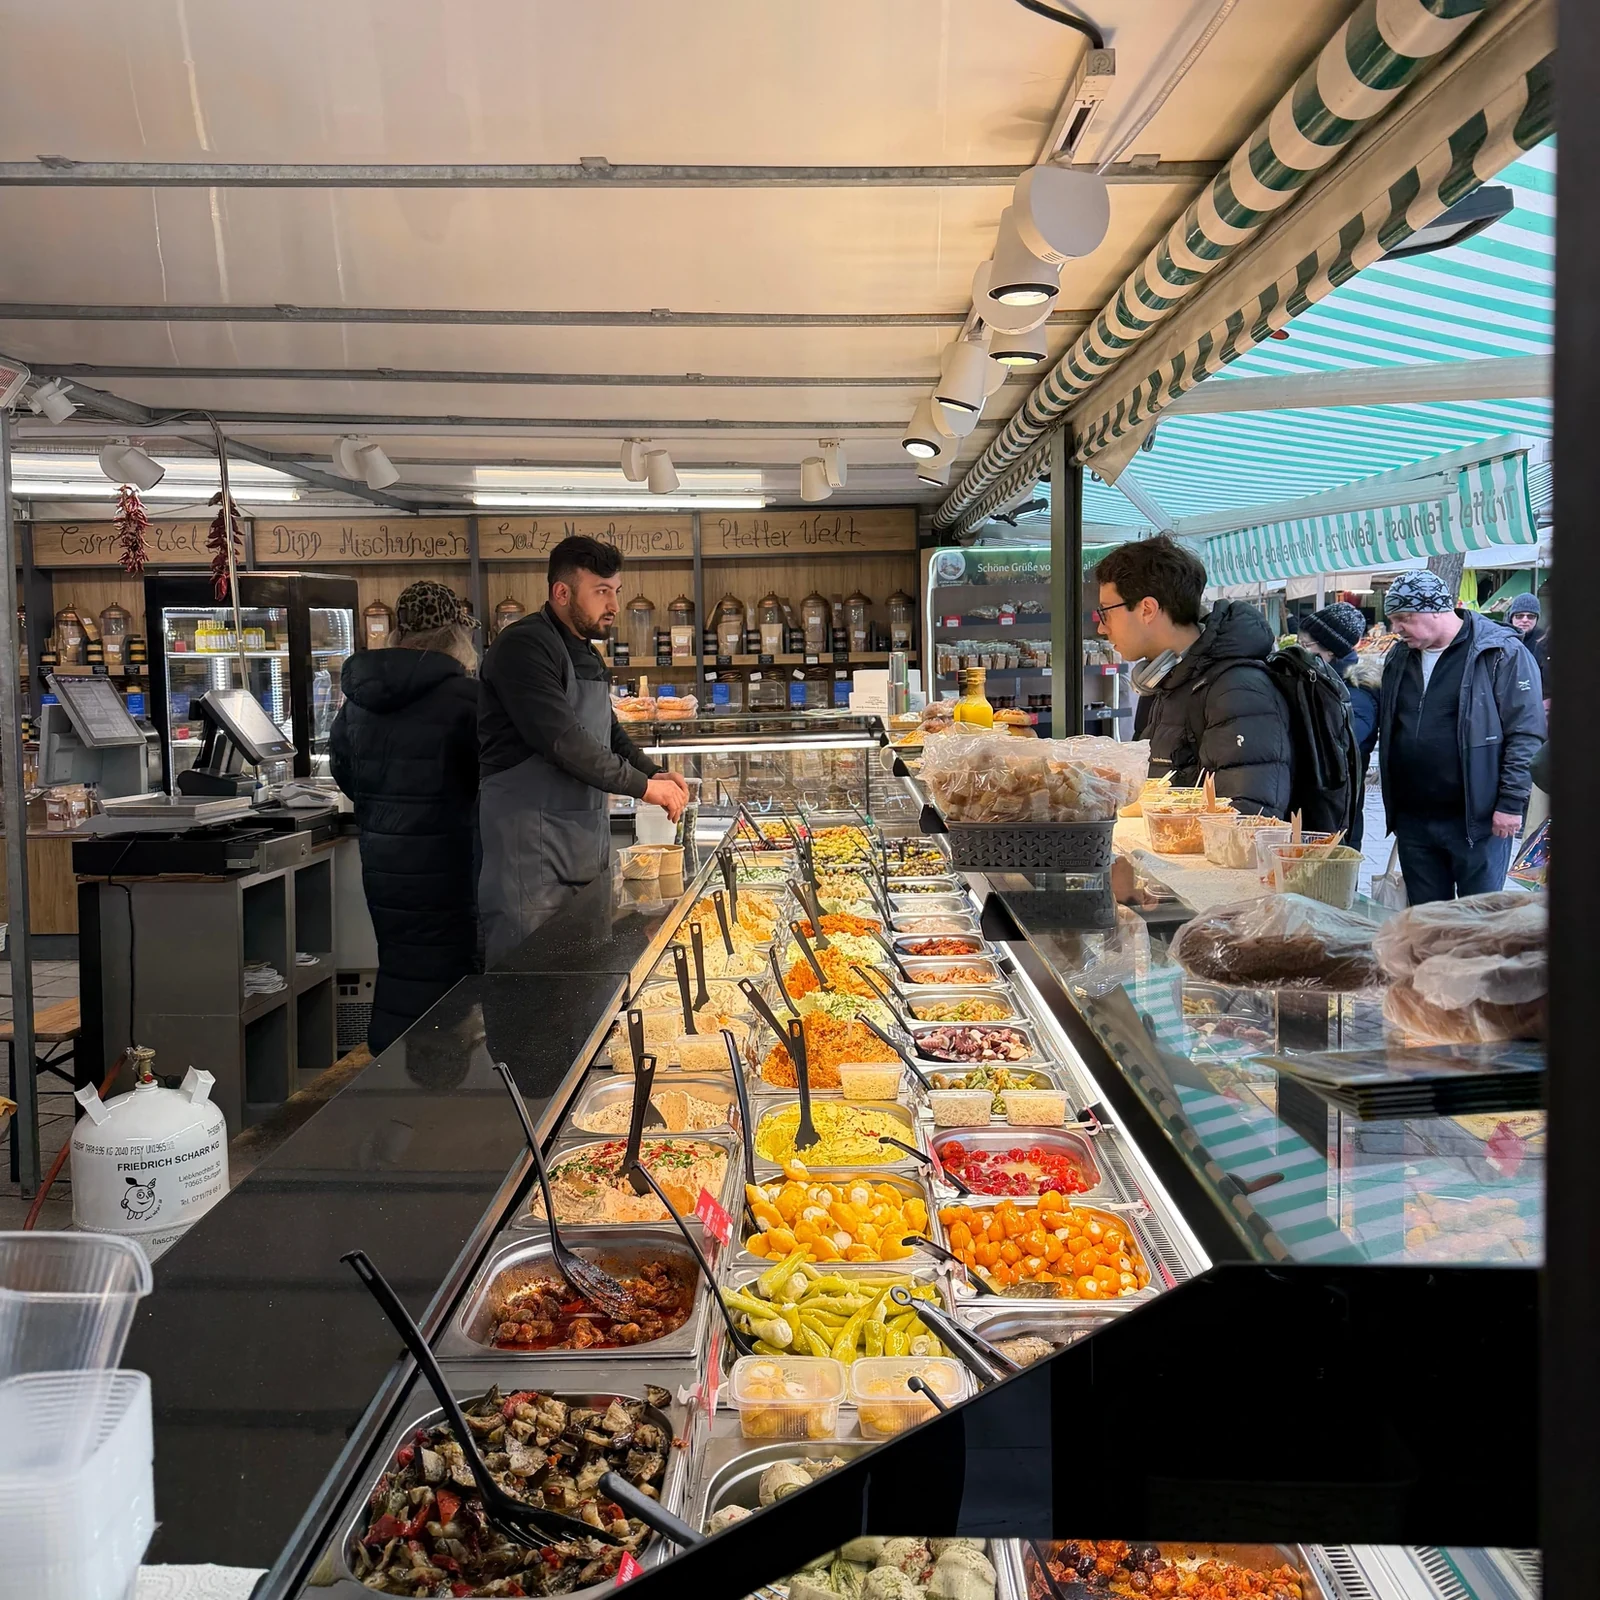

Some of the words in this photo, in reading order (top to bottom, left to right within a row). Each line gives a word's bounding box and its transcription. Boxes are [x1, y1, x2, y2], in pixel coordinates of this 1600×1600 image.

[60, 525, 122, 555] Curr
[270, 525, 322, 560] Dipp
[339, 524, 471, 558] Mischungen
[718, 517, 792, 549] Pfeffer
[800, 514, 866, 546] Welt
[977, 562, 1010, 573] Schöne
[1011, 561, 1038, 572] Grüße
[115, 1146, 129, 1156] 2040
[117, 1157, 173, 1172] FRIEDRICH
[174, 1145, 210, 1164] SCHARR
[210, 1140, 220, 1151] KG
